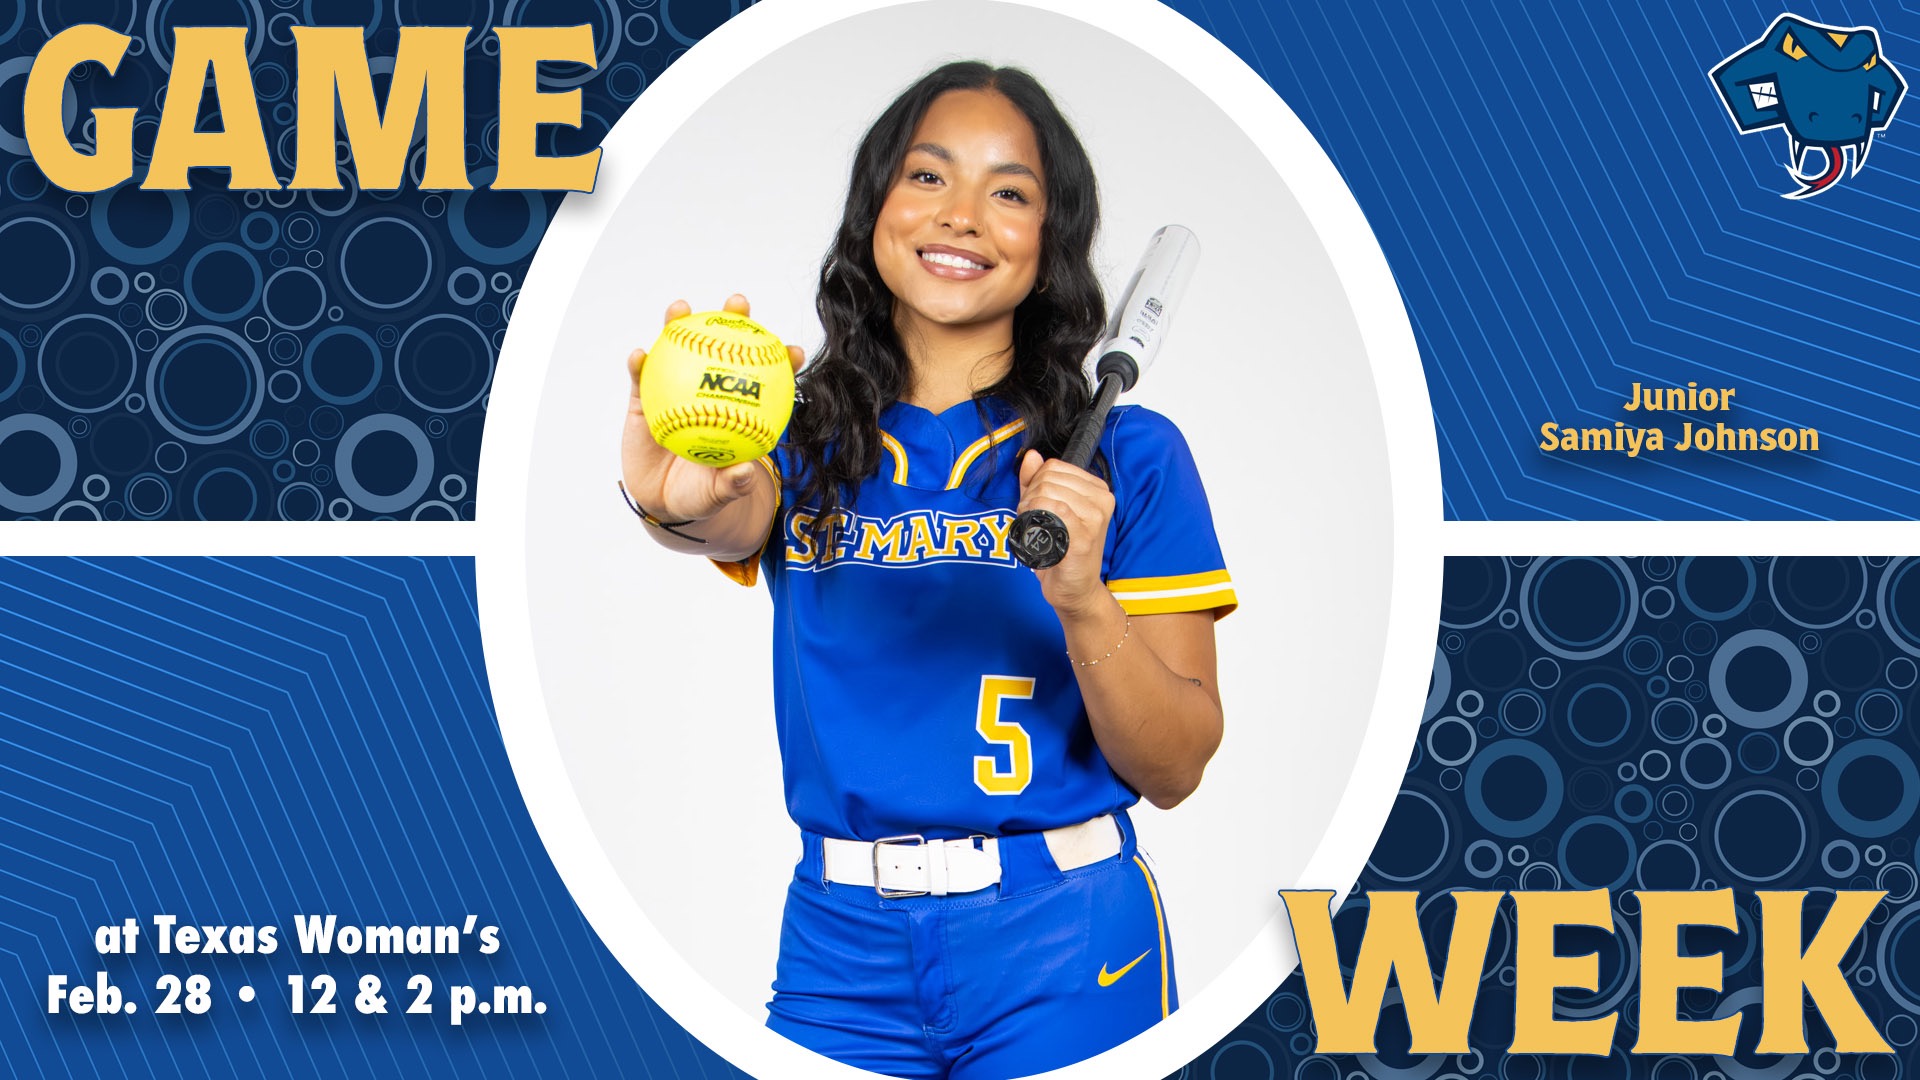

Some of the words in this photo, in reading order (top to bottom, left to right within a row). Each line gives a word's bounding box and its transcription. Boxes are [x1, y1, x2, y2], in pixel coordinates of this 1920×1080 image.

[699, 373, 761, 400] NCAA
[853, 514, 1016, 563] MARY
[1030, 531, 1049, 552] 34
[973, 674, 1037, 796] 5
